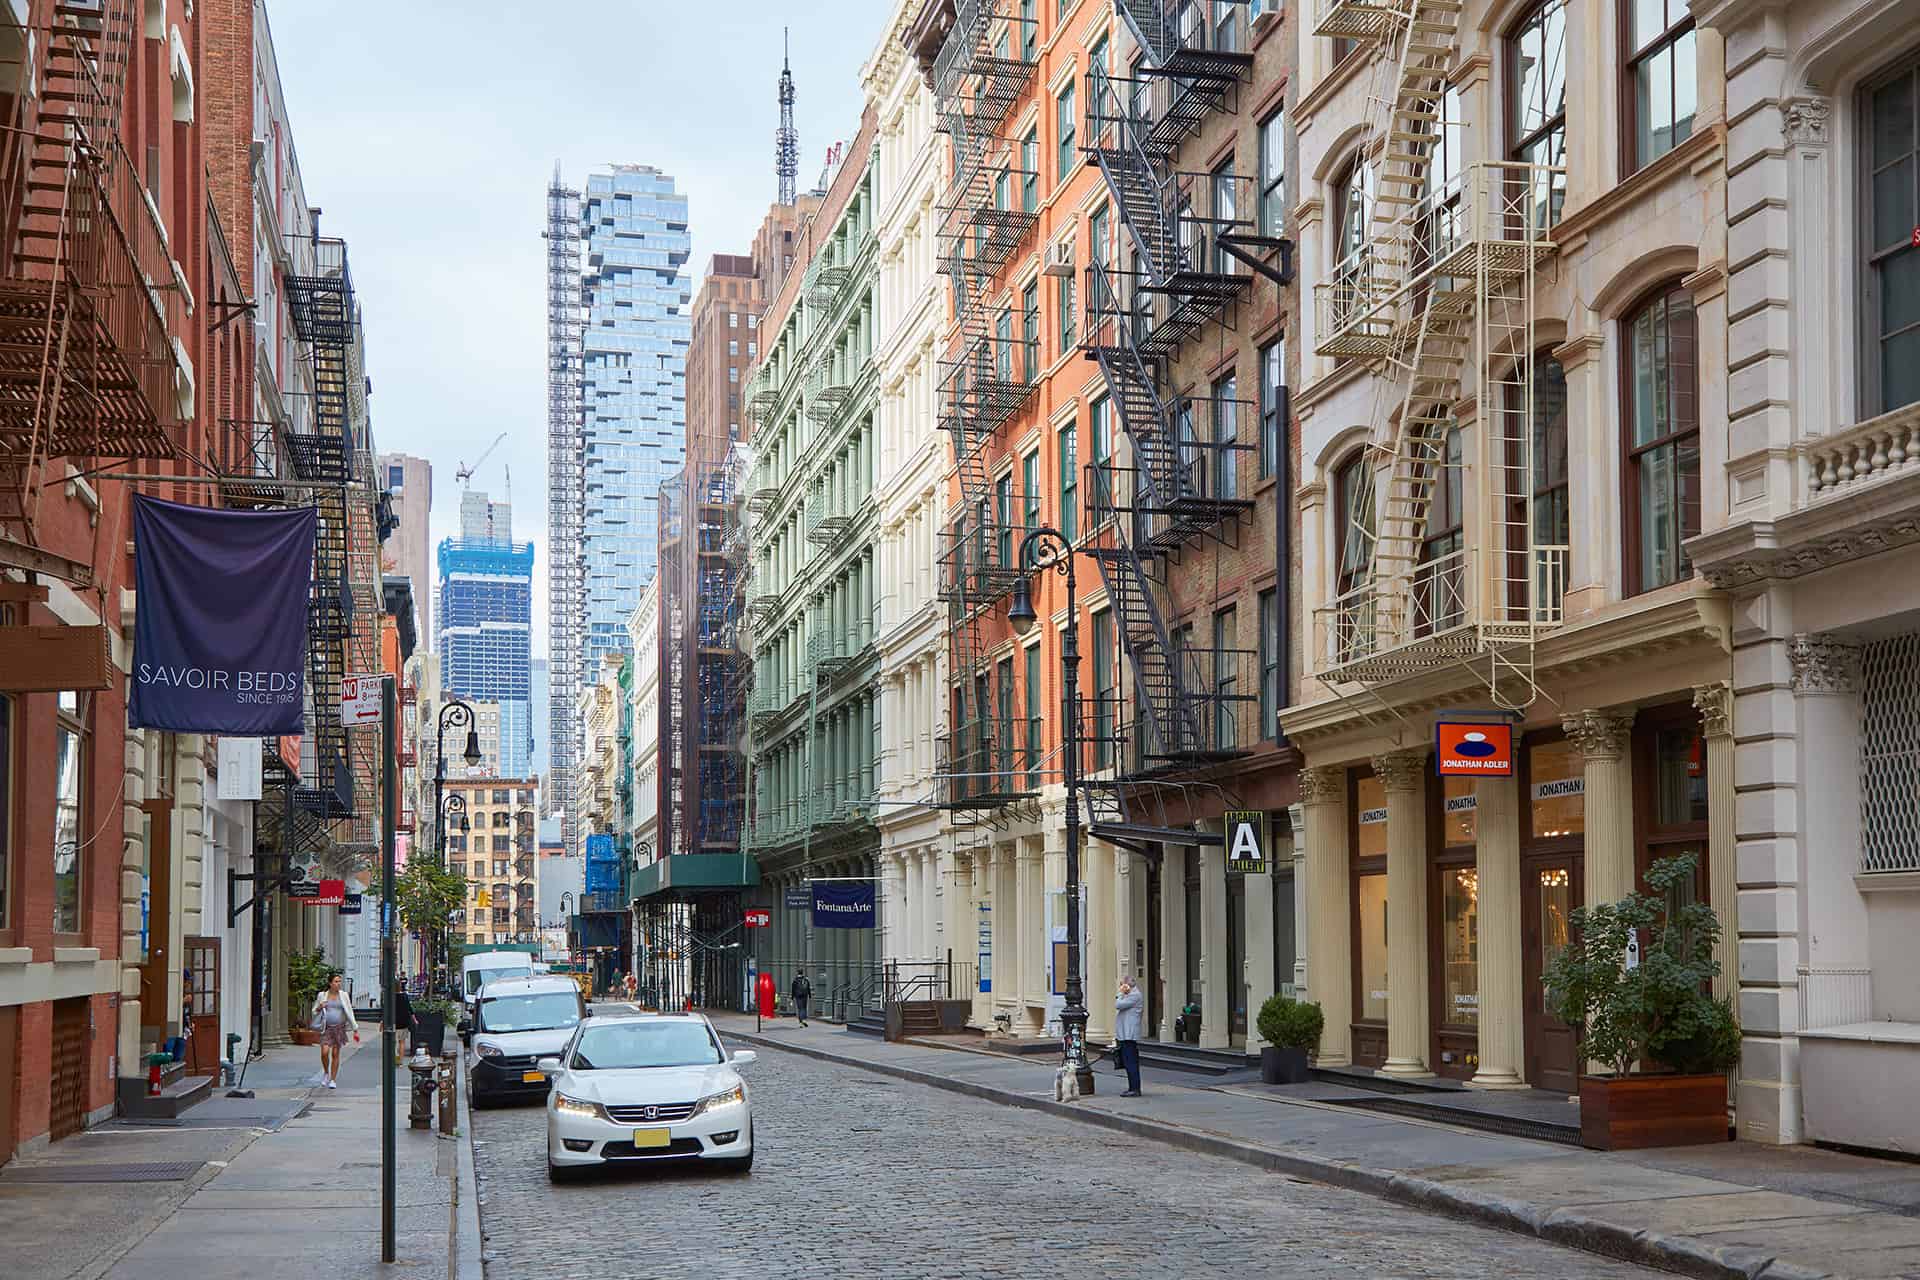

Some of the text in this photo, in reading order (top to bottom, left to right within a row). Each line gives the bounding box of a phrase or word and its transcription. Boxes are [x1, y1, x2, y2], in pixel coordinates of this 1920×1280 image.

[138, 663, 297, 691] SAVOIR BEDS
[344, 681, 357, 698] NO
[237, 692, 273, 704] SINCE
[1442, 760, 1482, 768] JONATHAN
[1540, 781, 1580, 797] JONATHAN
[1447, 797, 1477, 810] JONATHA
[1363, 809, 1387, 822] JONATHA
[1230, 823, 1261, 860] A
[816, 899, 872, 912] FontanaArte
